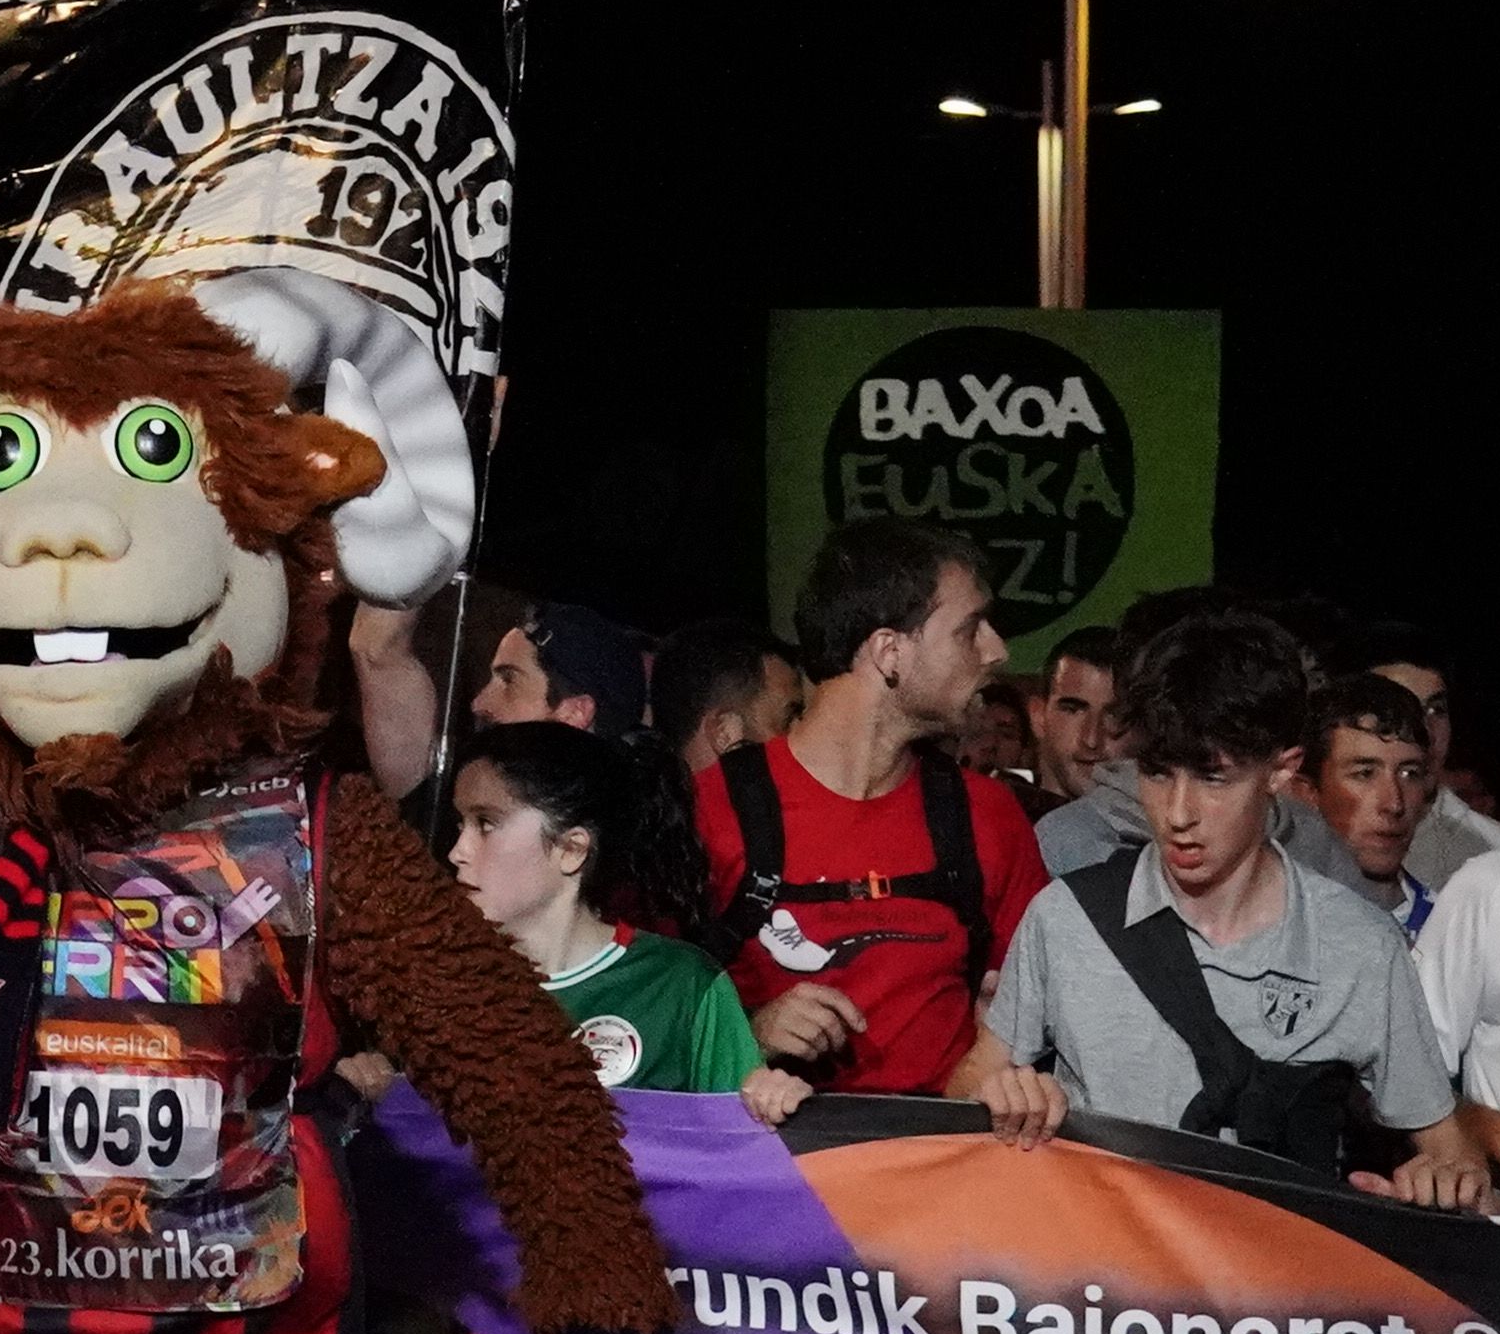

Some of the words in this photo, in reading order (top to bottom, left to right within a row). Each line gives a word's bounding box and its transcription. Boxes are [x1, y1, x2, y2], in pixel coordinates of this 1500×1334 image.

[858, 373, 1105, 441] BAXOA
[840, 442, 1125, 520] EUSKA
[45, 1032, 170, 1059] euskaltel
[27, 1085, 185, 1167] 1059
